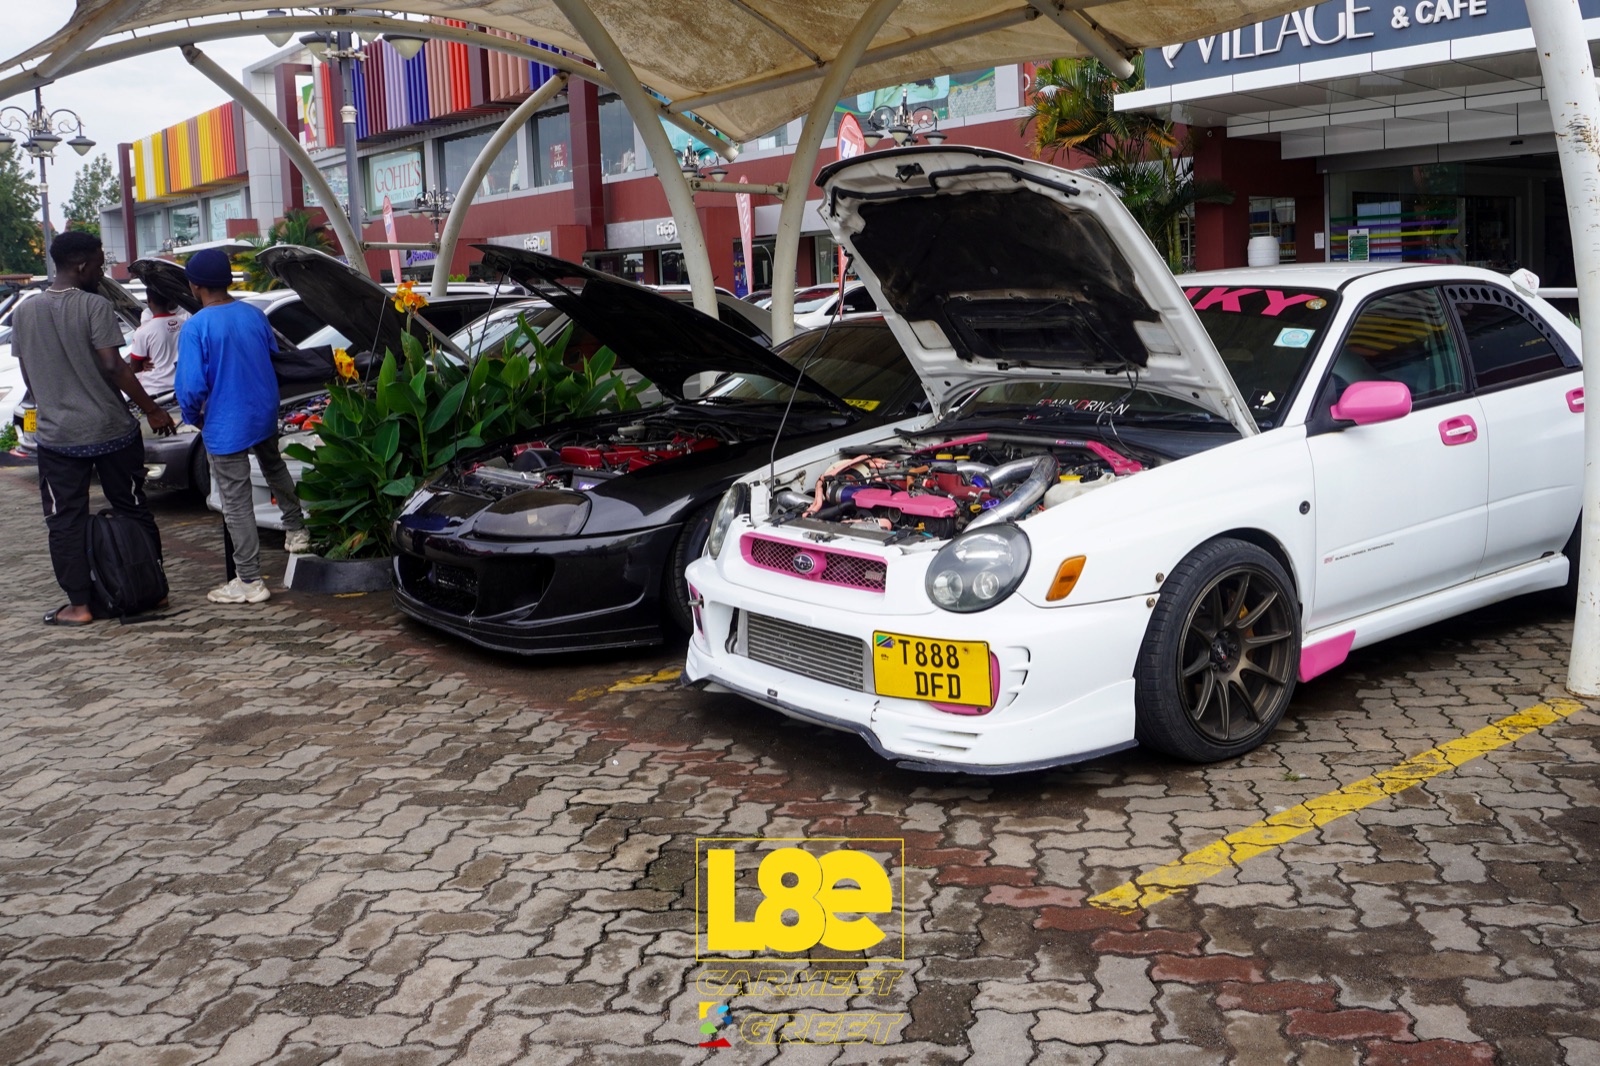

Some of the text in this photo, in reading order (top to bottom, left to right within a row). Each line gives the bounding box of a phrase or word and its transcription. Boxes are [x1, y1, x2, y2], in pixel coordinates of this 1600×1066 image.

[1391, 6, 1410, 29] &
[375, 159, 421, 193] GOHIL'S
[914, 671, 961, 699] DFD
